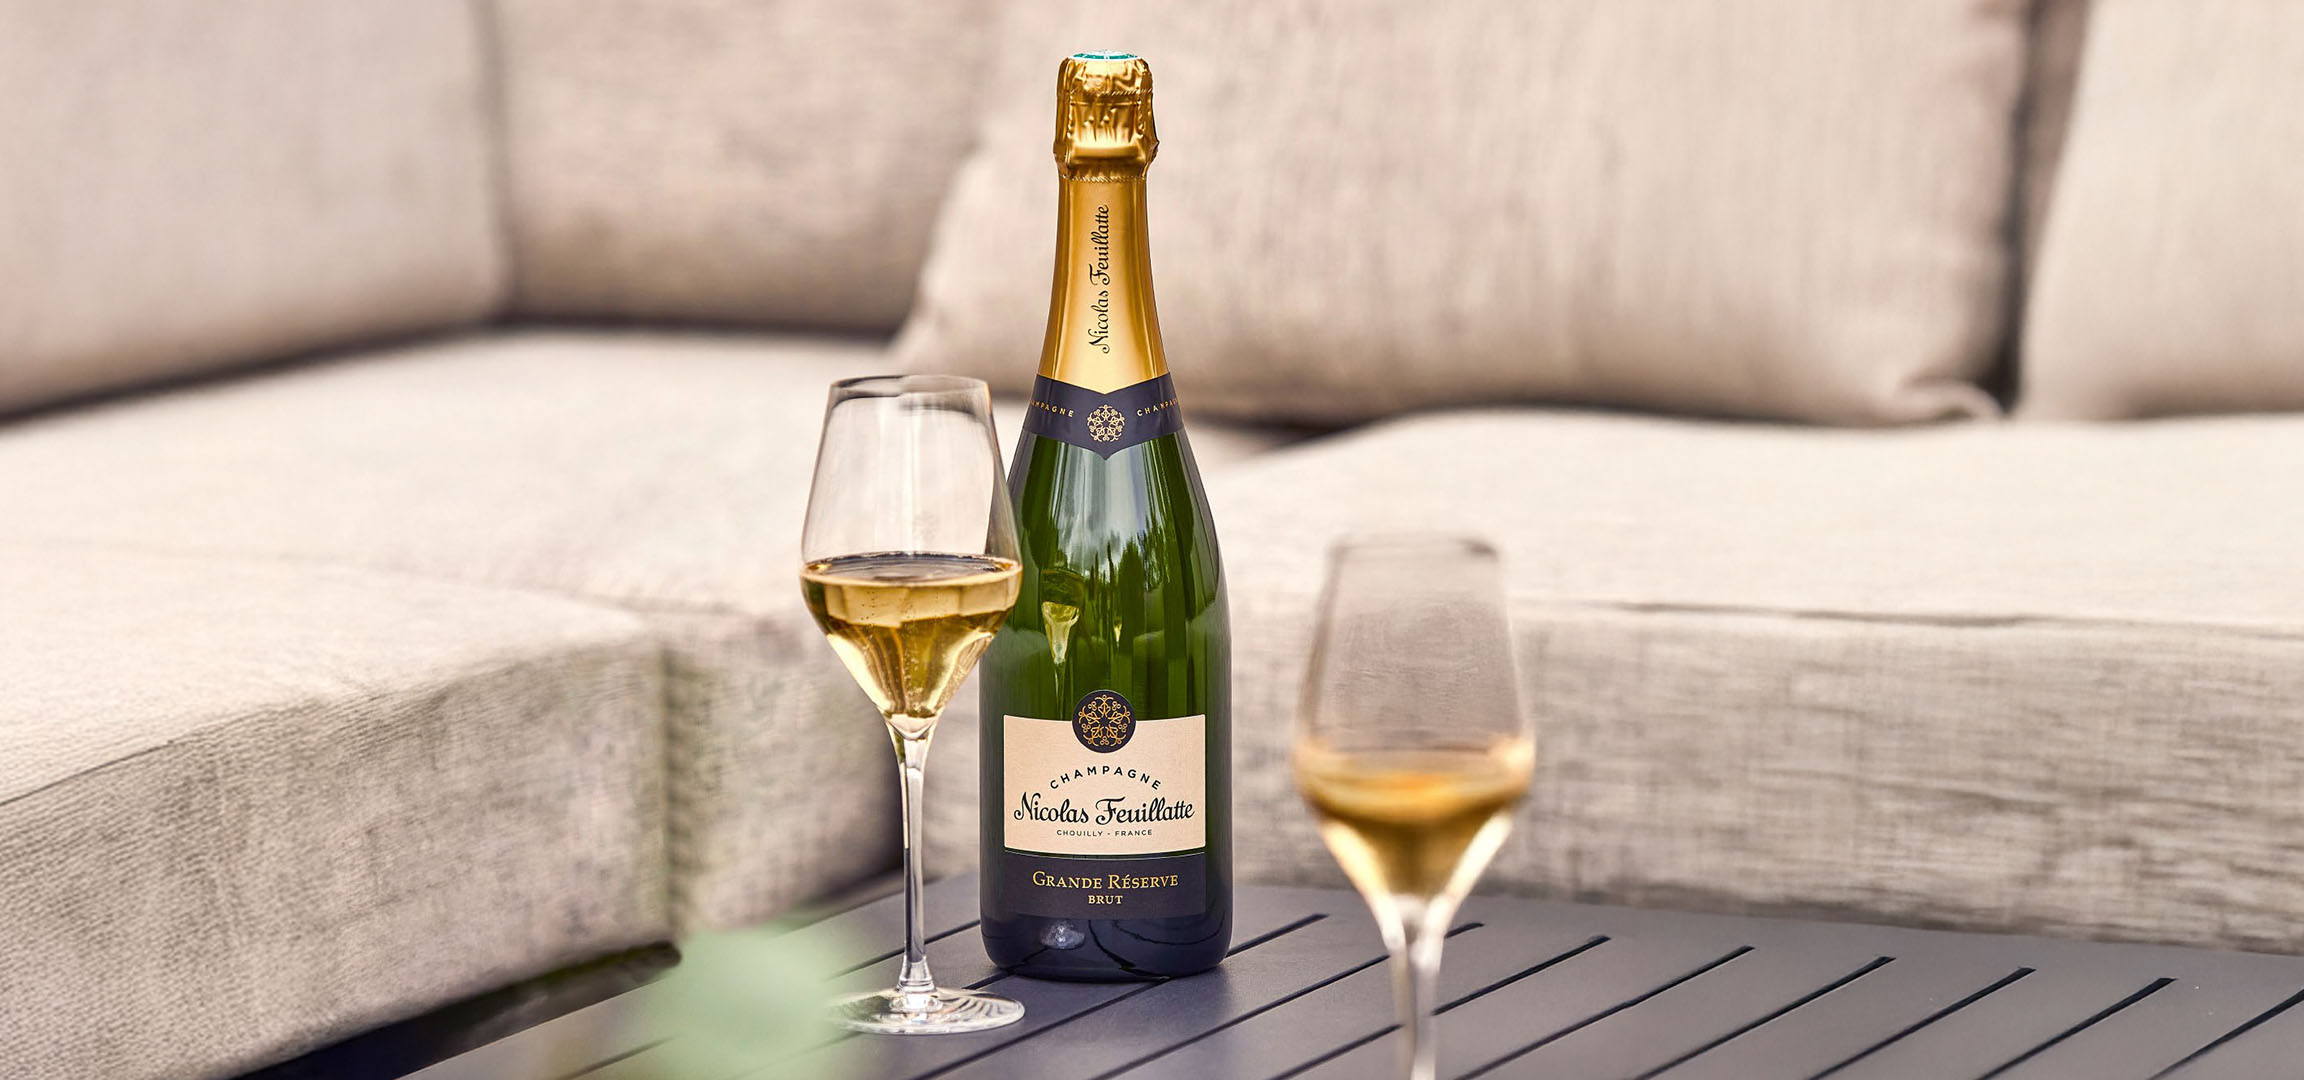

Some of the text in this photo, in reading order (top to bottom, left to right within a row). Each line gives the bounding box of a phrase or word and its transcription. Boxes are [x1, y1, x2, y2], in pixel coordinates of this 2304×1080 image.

[1088, 204, 1110, 354] Nicolas Feuillatte
[1050, 765, 1161, 790] CHAMPAGNE
[1013, 791, 1195, 826] Nicolas Feuillatte
[1056, 829, 1103, 837] CHOUILLY
[1115, 829, 1153, 837] FRANCE
[1088, 896, 1123, 905] BRUT
